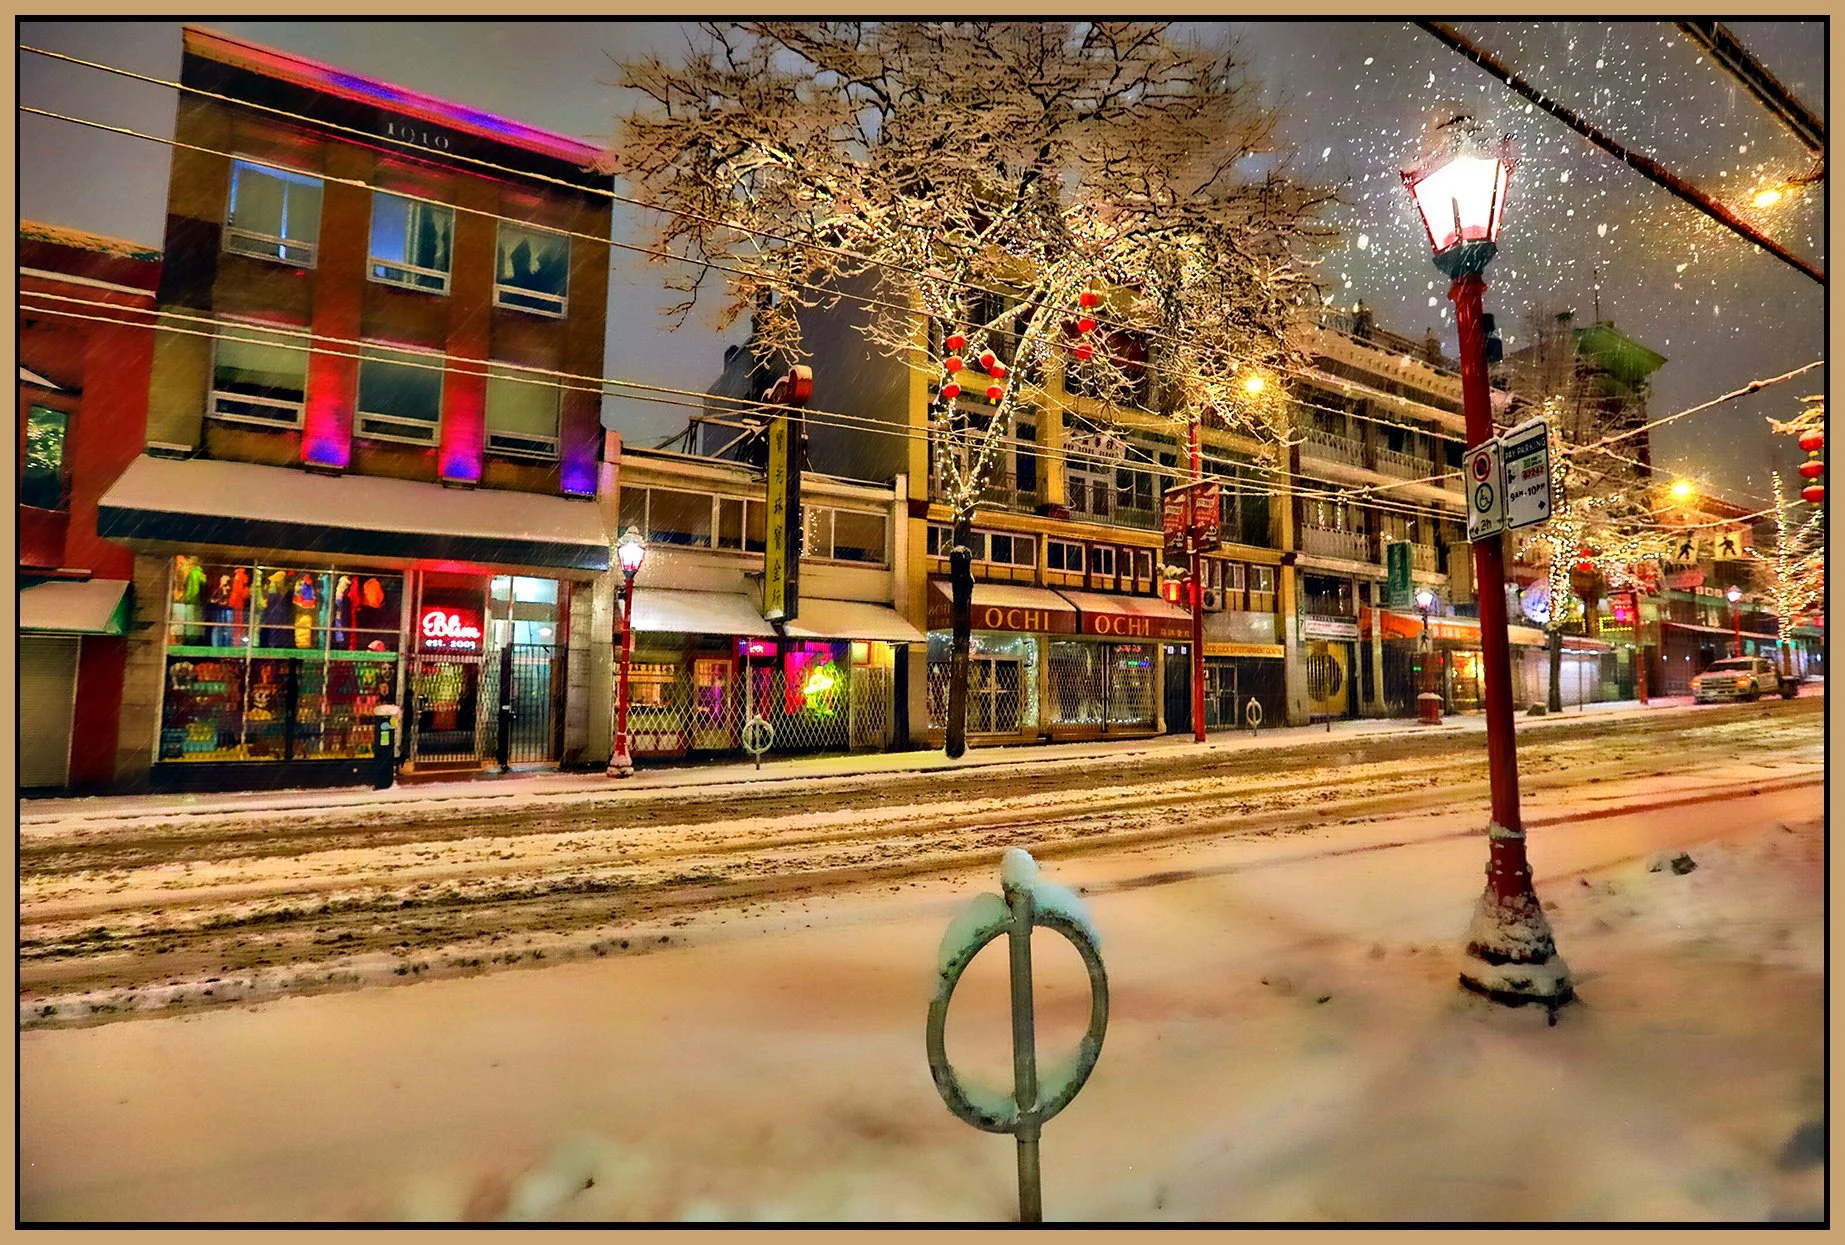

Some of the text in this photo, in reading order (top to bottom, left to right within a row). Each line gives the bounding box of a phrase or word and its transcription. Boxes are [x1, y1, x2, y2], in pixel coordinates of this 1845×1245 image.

[1505, 437, 1546, 460] PAY PARKING
[1480, 518, 1493, 532] 2h
[422, 611, 481, 638] Blim
[985, 607, 1049, 631] OCHI
[1094, 615, 1150, 637] OCHI
[425, 639, 446, 648] est.
